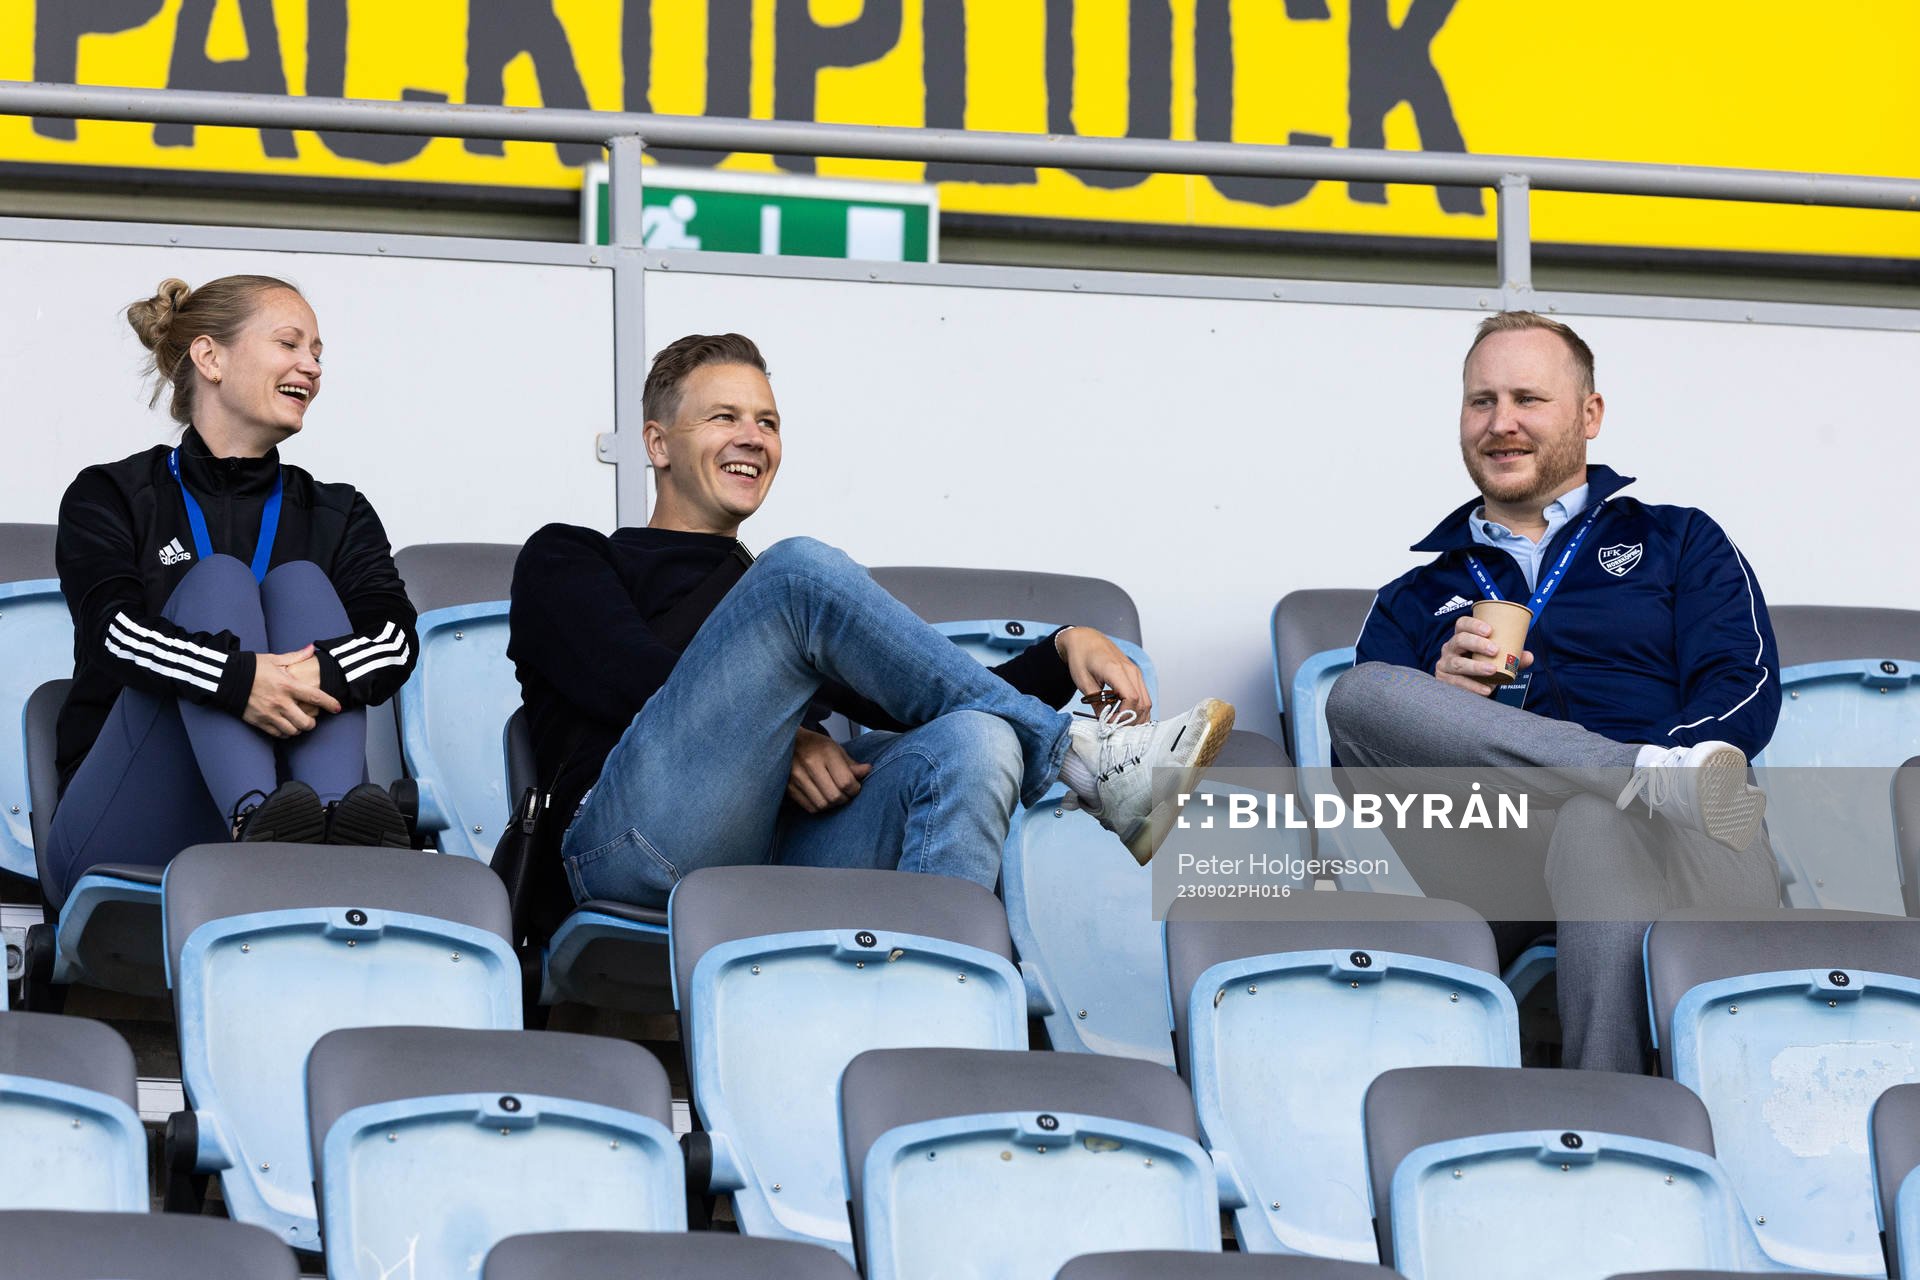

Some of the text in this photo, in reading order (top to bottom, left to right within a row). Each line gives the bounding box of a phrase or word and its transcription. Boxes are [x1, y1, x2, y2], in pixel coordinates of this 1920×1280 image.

[1602, 549, 1621, 558] IFK
[1010, 625, 1021, 633] 11
[352, 913, 361, 922] 9
[859, 935, 872, 944] 10
[1355, 956, 1367, 964] 11
[1833, 974, 1846, 983] 12
[1041, 1117, 1055, 1128] 10
